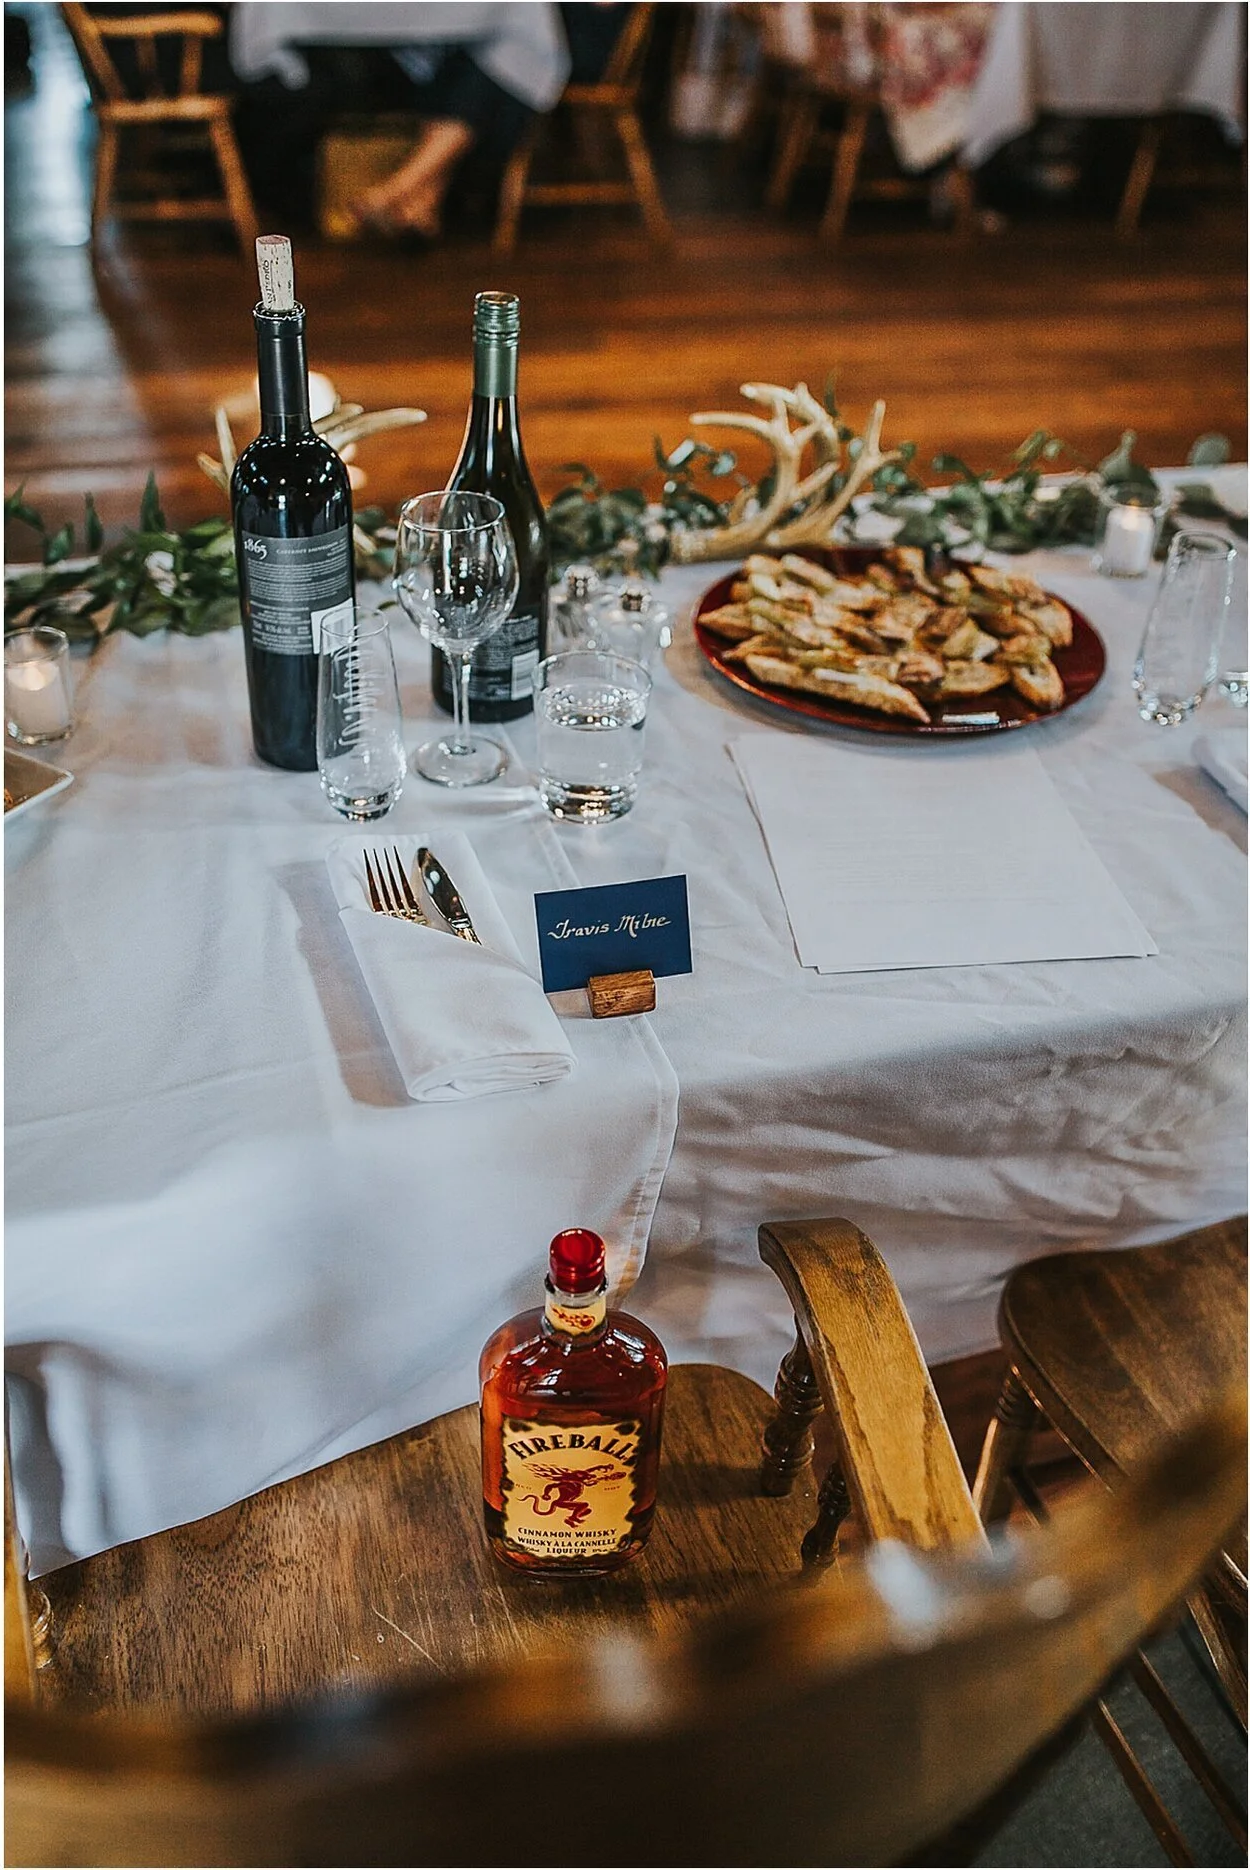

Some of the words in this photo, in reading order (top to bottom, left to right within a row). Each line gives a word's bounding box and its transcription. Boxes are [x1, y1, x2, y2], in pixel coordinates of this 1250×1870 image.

[244, 538, 268, 560] 1865
[547, 918, 610, 939] Travis
[614, 912, 672, 938] Milne
[508, 1433, 634, 1460] FIREBALL
[518, 1527, 572, 1538] CINNAMON
[575, 1528, 617, 1538] WHISKY
[517, 1536, 553, 1547] WHISKY
[574, 1538, 616, 1547] CANNELLE
[547, 1547, 587, 1555] LIQUEUR
